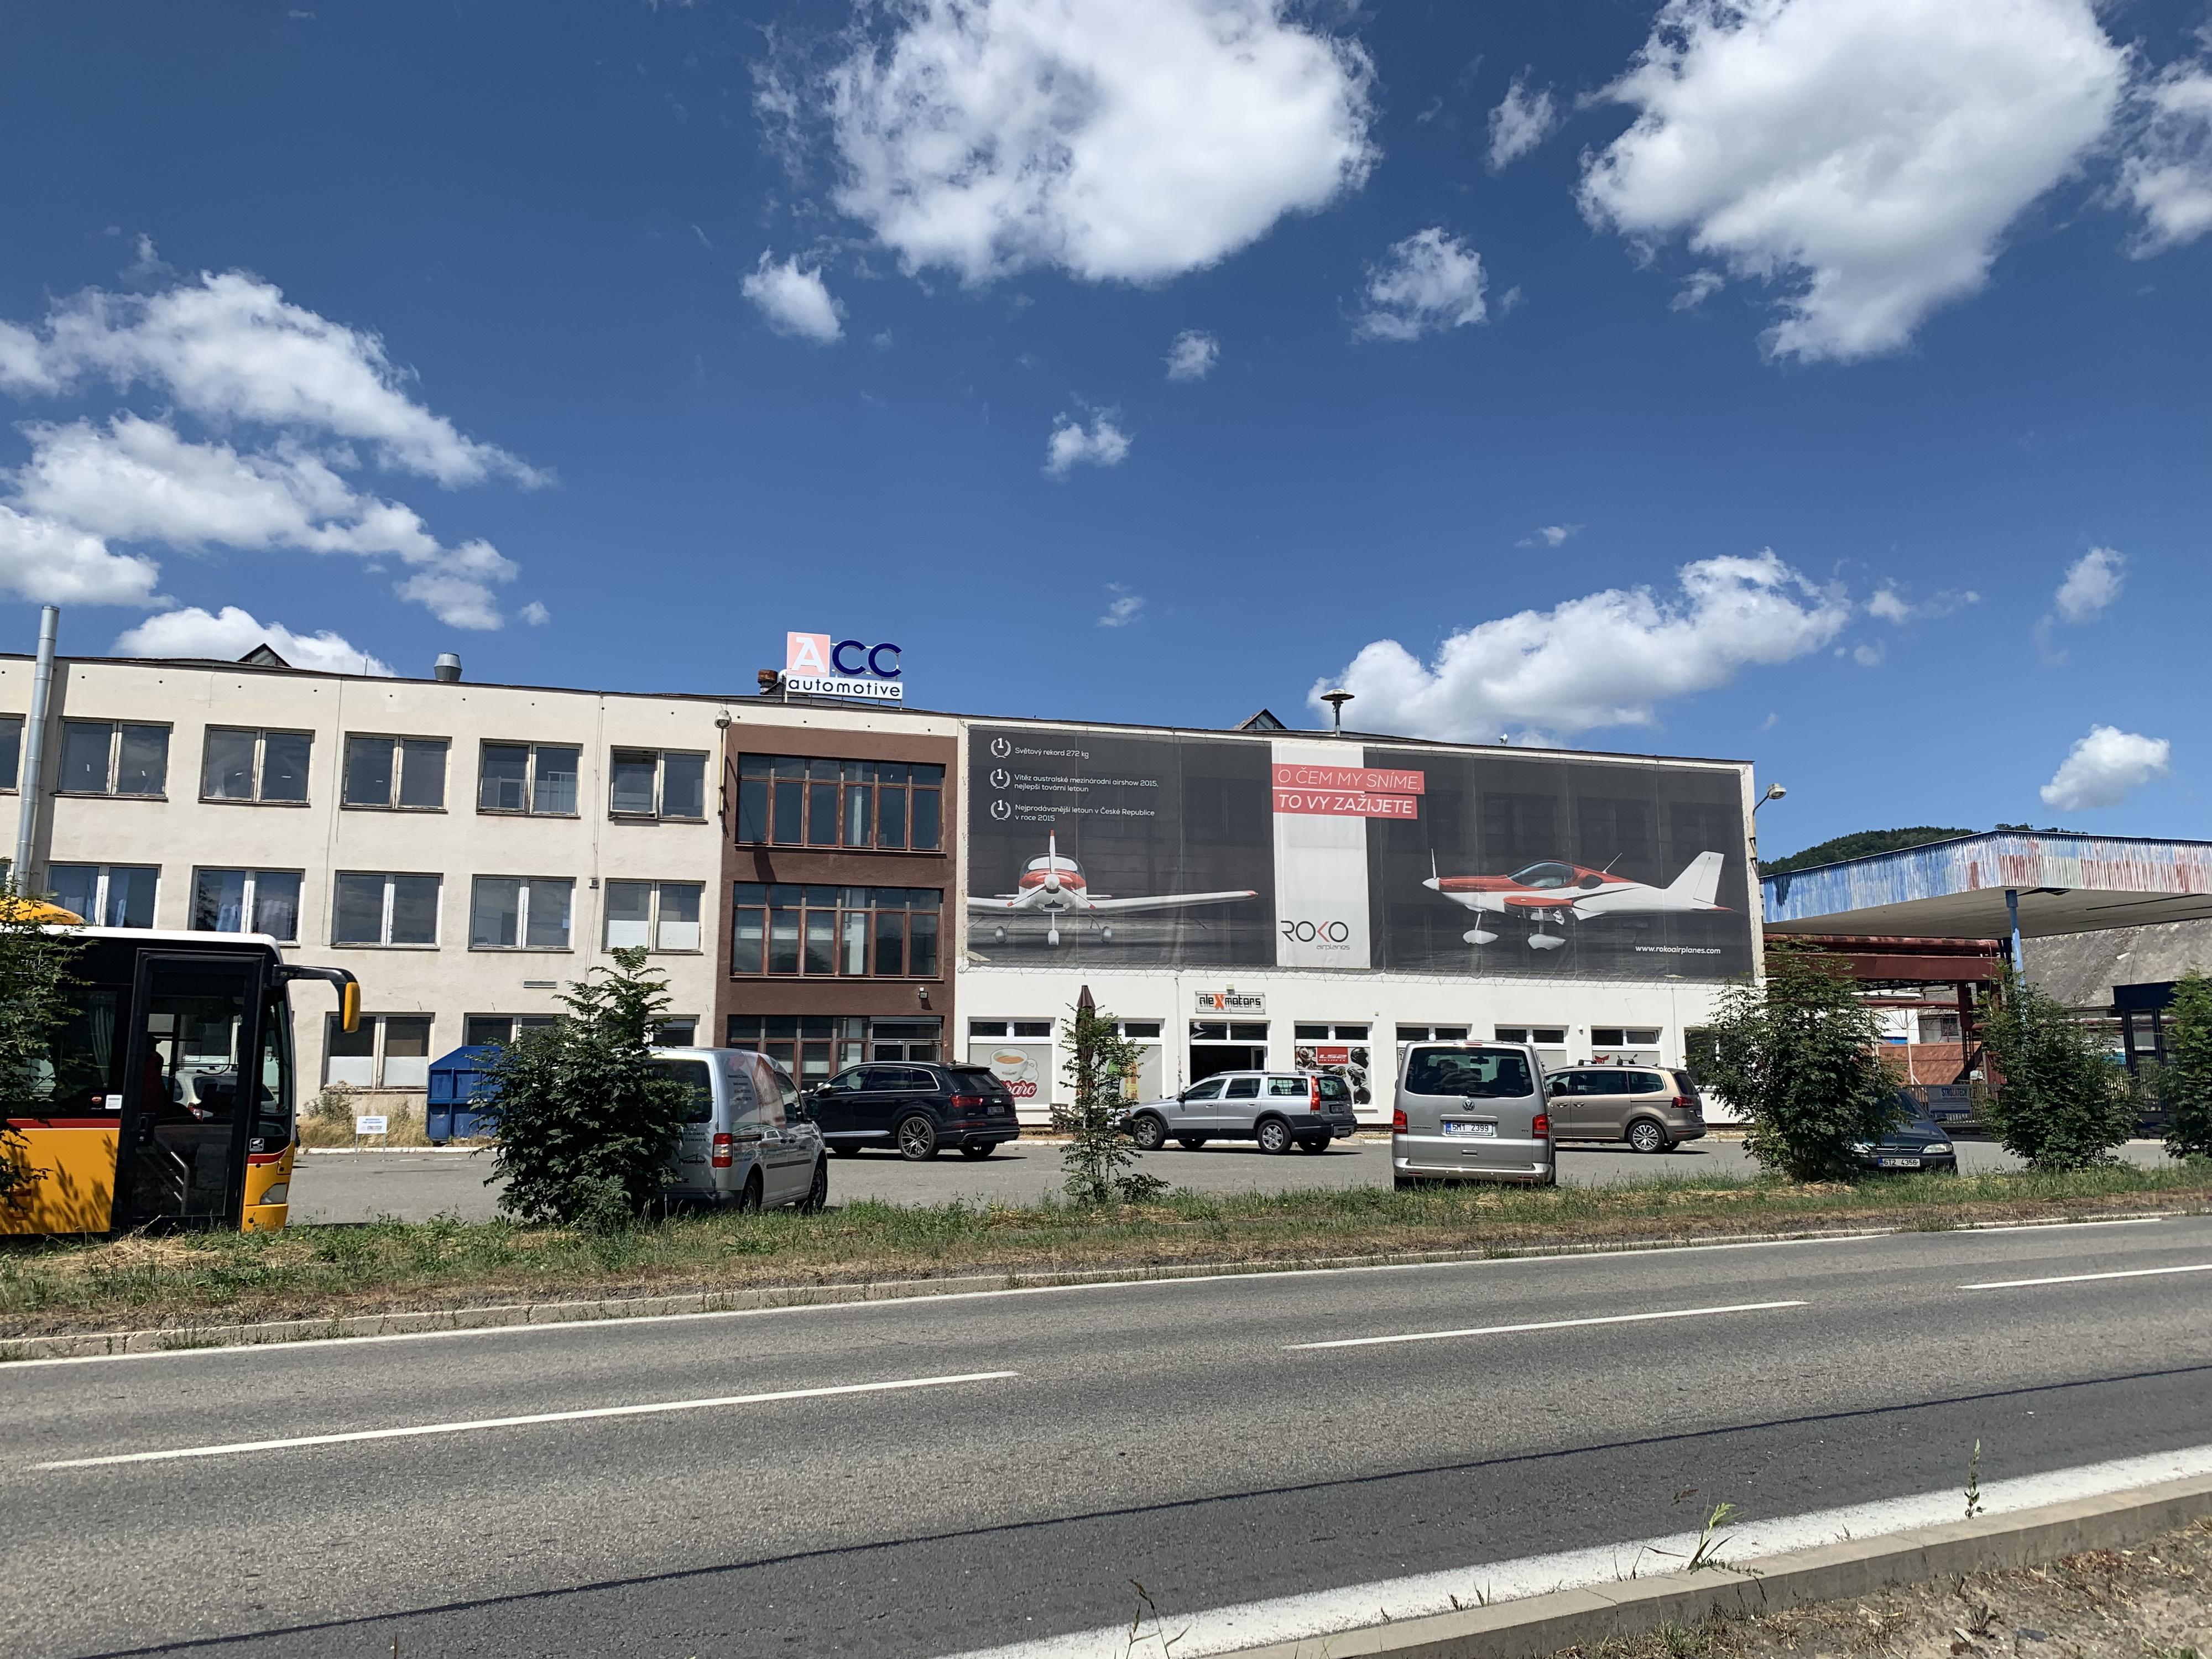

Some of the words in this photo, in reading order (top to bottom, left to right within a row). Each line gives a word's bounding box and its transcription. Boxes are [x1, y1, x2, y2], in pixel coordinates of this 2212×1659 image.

[791, 637, 902, 679] ACC
[788, 678, 900, 697] automotive
[1015, 747, 1042, 757] Světový
[1081, 750, 1089, 759] kg
[1033, 775, 1068, 784] australské
[1070, 776, 1111, 785] mezinárodní
[1140, 779, 1159, 787] 2015,
[1278, 769, 1291, 783] O
[1296, 766, 1333, 785] ČEM
[1337, 772, 1363, 786] MY
[1365, 771, 1421, 792] SNÍME,
[1014, 783, 1040, 791] nejlepší
[1015, 804, 1071, 815] Nejprodávanější
[1100, 806, 1120, 815] České
[1121, 808, 1155, 817] Republice
[1278, 794, 1302, 809] TO
[1306, 795, 1330, 810] VY
[1333, 794, 1413, 815] ZAŽIJETE
[1280, 920, 1349, 943] ROKO
[1635, 945, 1721, 955] www.rokoairplanes.com
[1452, 1122, 1465, 1131] 5M1
[1471, 1123, 1489, 1132] 2399
